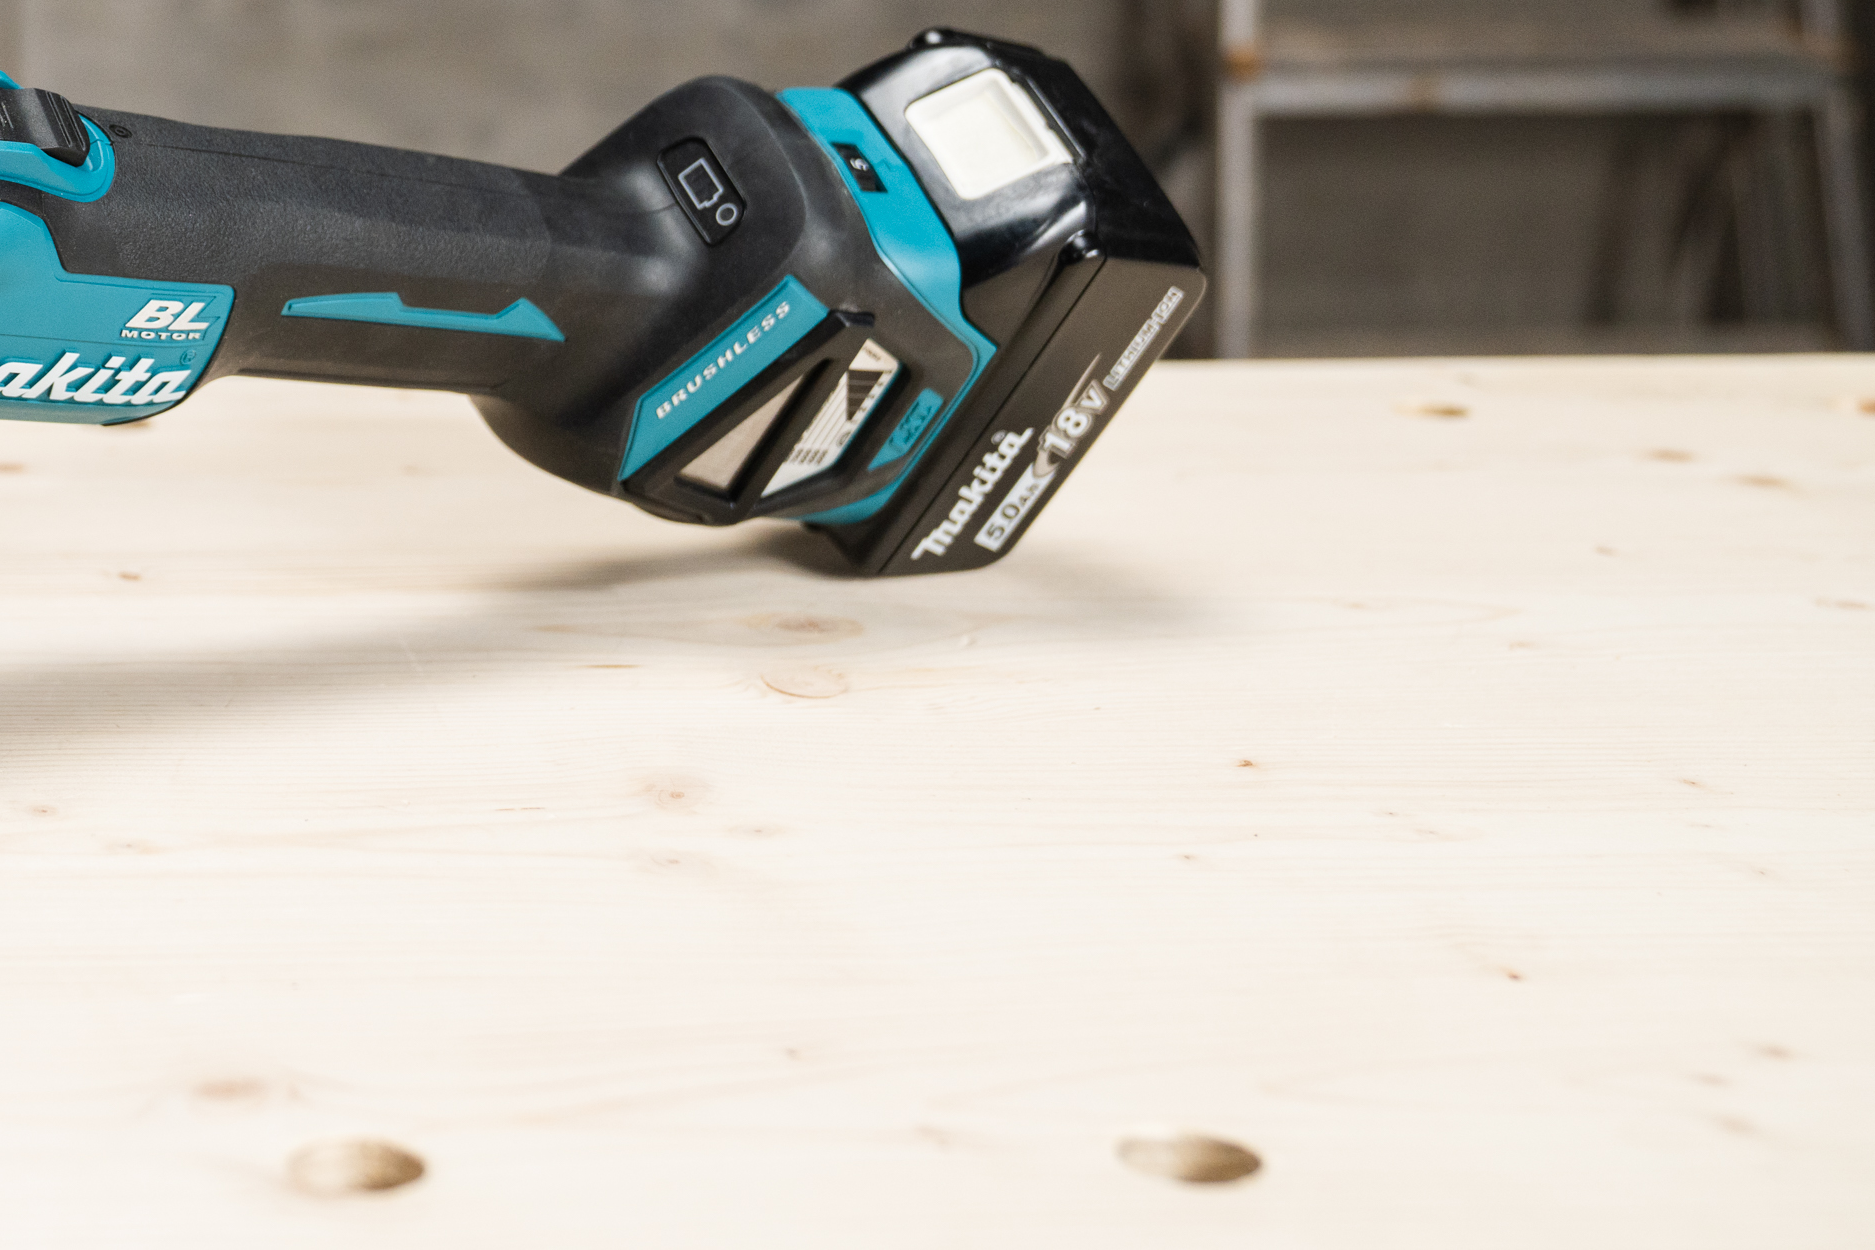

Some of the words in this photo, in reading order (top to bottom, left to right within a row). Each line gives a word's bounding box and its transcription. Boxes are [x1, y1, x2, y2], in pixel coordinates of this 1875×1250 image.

[125, 299, 210, 331] BL
[120, 329, 201, 341] MOTOR
[656, 301, 790, 419] BRUSHLESS
